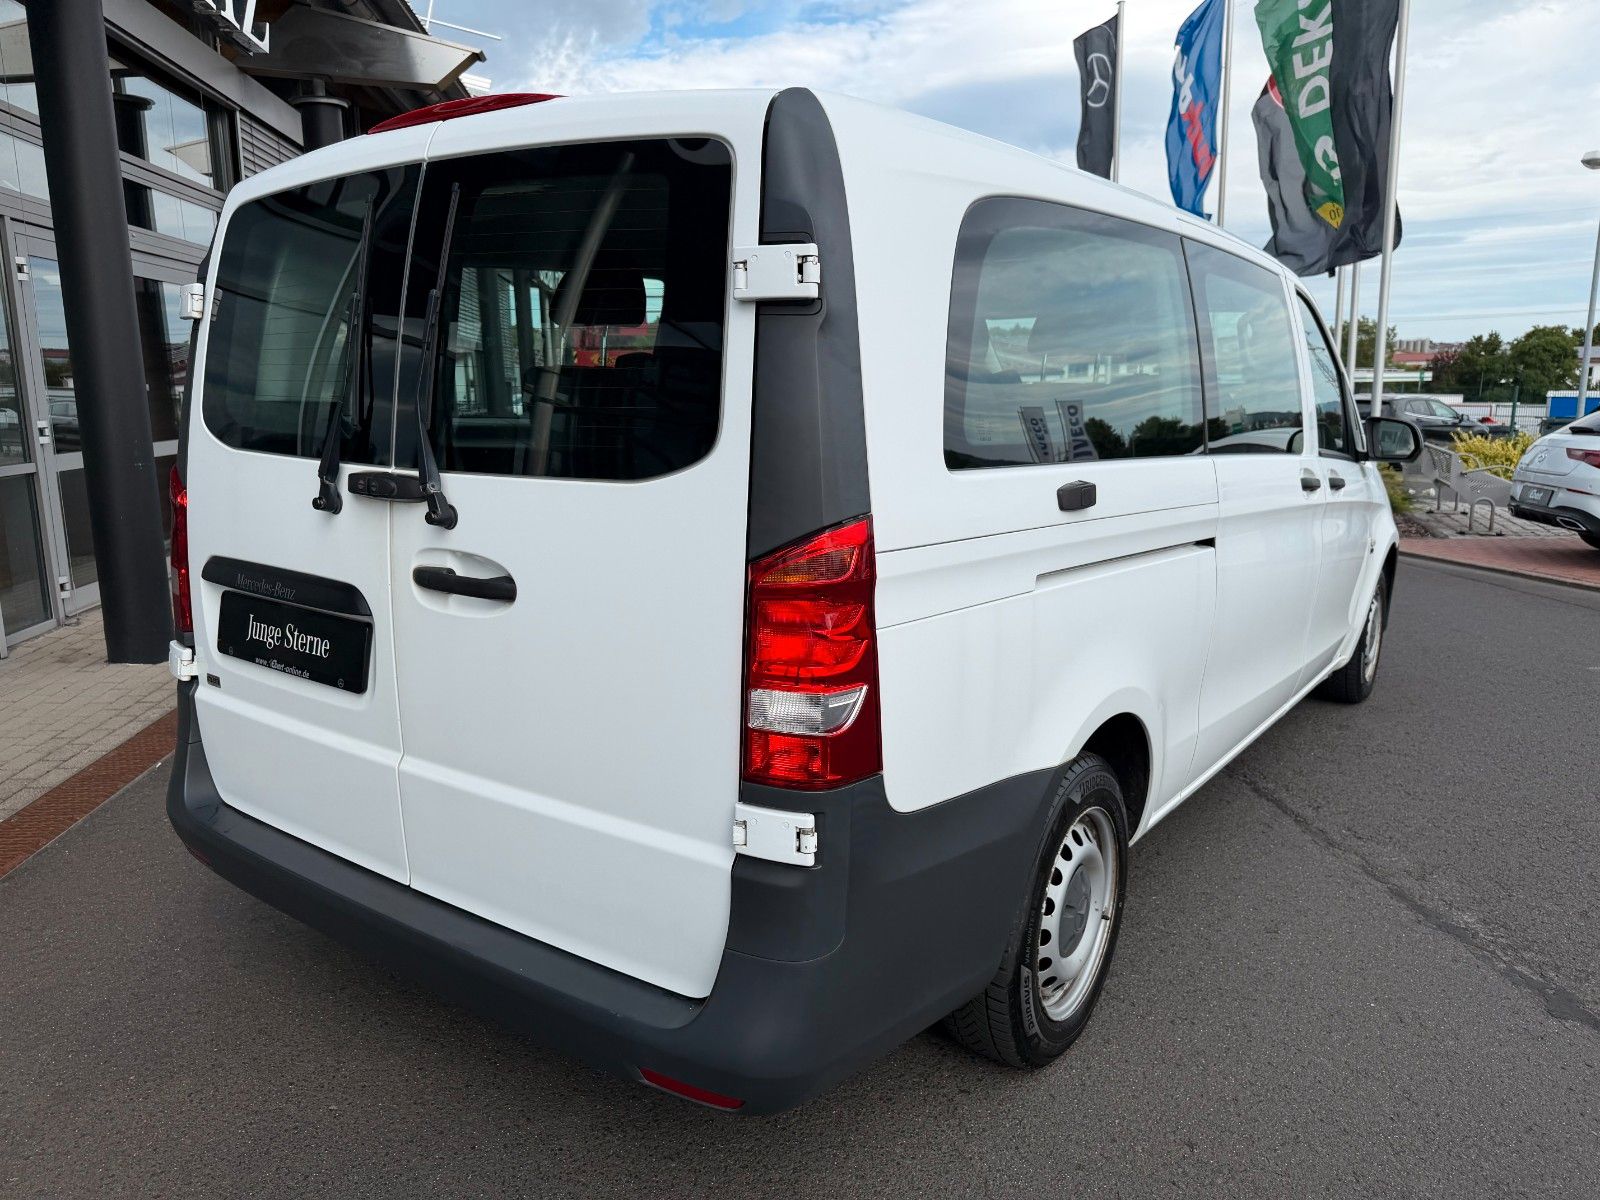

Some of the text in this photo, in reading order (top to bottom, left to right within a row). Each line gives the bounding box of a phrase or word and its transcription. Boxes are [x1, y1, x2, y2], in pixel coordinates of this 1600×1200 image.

[1292, 0, 1333, 119] DEK
[1067, 405, 1093, 459] IVECO
[235, 573, 296, 600] Mercedes-Benz
[246, 613, 330, 658] Junge Sterne
[1023, 975, 1035, 1030] DURAVIS
